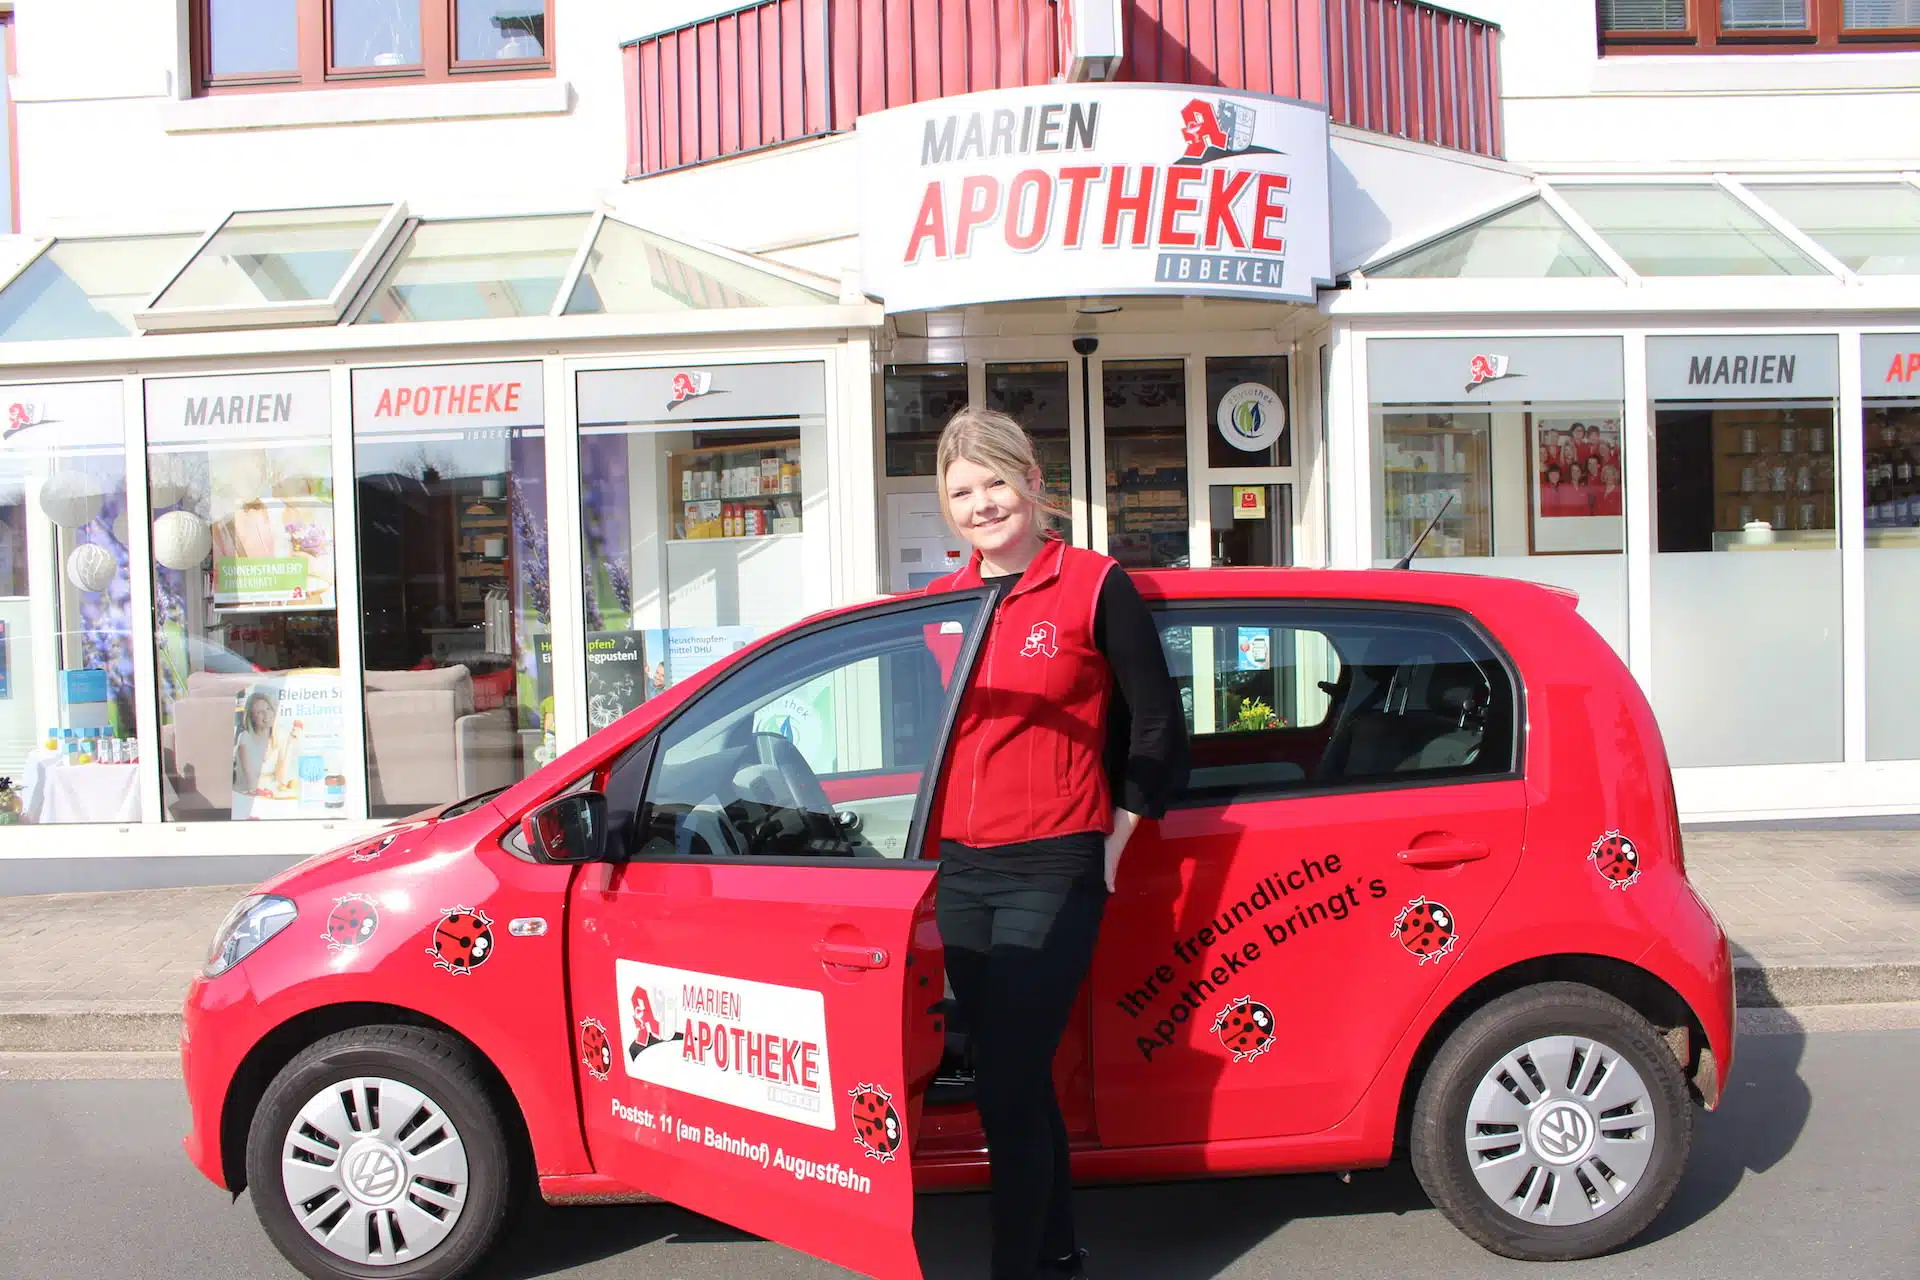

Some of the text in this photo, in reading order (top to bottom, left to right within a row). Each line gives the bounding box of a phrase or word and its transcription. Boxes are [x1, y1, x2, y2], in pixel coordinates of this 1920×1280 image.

[920, 102, 1099, 167] MARIEN
[903, 164, 1291, 265] APOTHEKE
[1163, 257, 1282, 285] IBBEKEN
[1688, 354, 1796, 385] MARIEN
[1885, 352, 1920, 382] AP
[184, 392, 292, 426] MARIEN
[374, 382, 521, 418] APOTHEKE
[586, 650, 638, 664] egpusten!
[668, 644, 713, 655] mittel DHU
[278, 688, 328, 701] Bleiben
[280, 704, 293, 717] in
[1116, 853, 1343, 1018] Ihre freundliche
[681, 983, 742, 1020] MARIEN
[1135, 941, 1262, 1063] Apotheke
[681, 1017, 821, 1092] APOTHEKE
[611, 1097, 872, 1195] Poststr. 11 (am Bahnhof) Augustfehn
